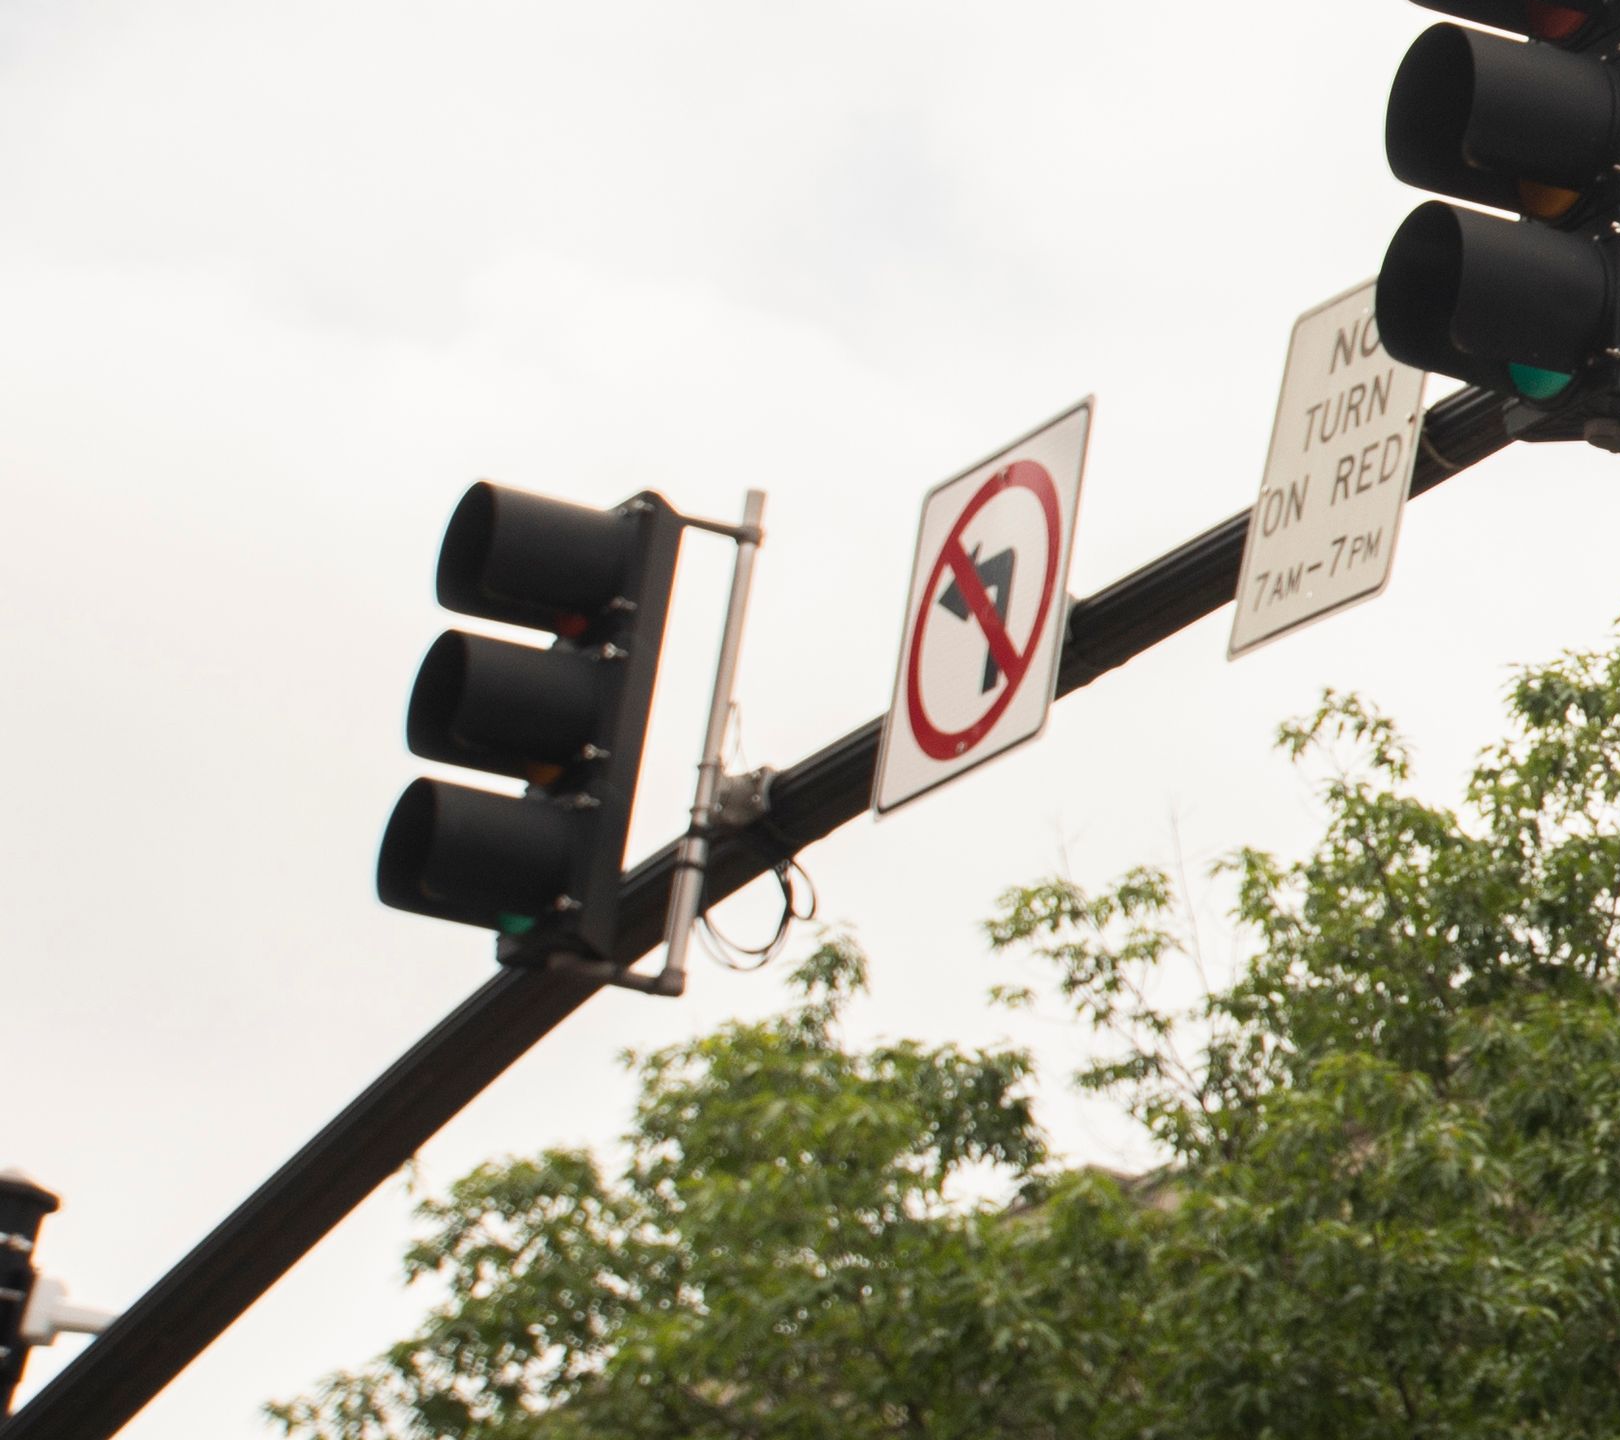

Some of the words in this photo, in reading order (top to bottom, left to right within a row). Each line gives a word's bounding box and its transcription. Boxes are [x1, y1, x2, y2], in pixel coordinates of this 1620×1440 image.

[1303, 368, 1394, 452] TURN
[1263, 474, 1310, 537] ON
[1330, 433, 1403, 506] RED
